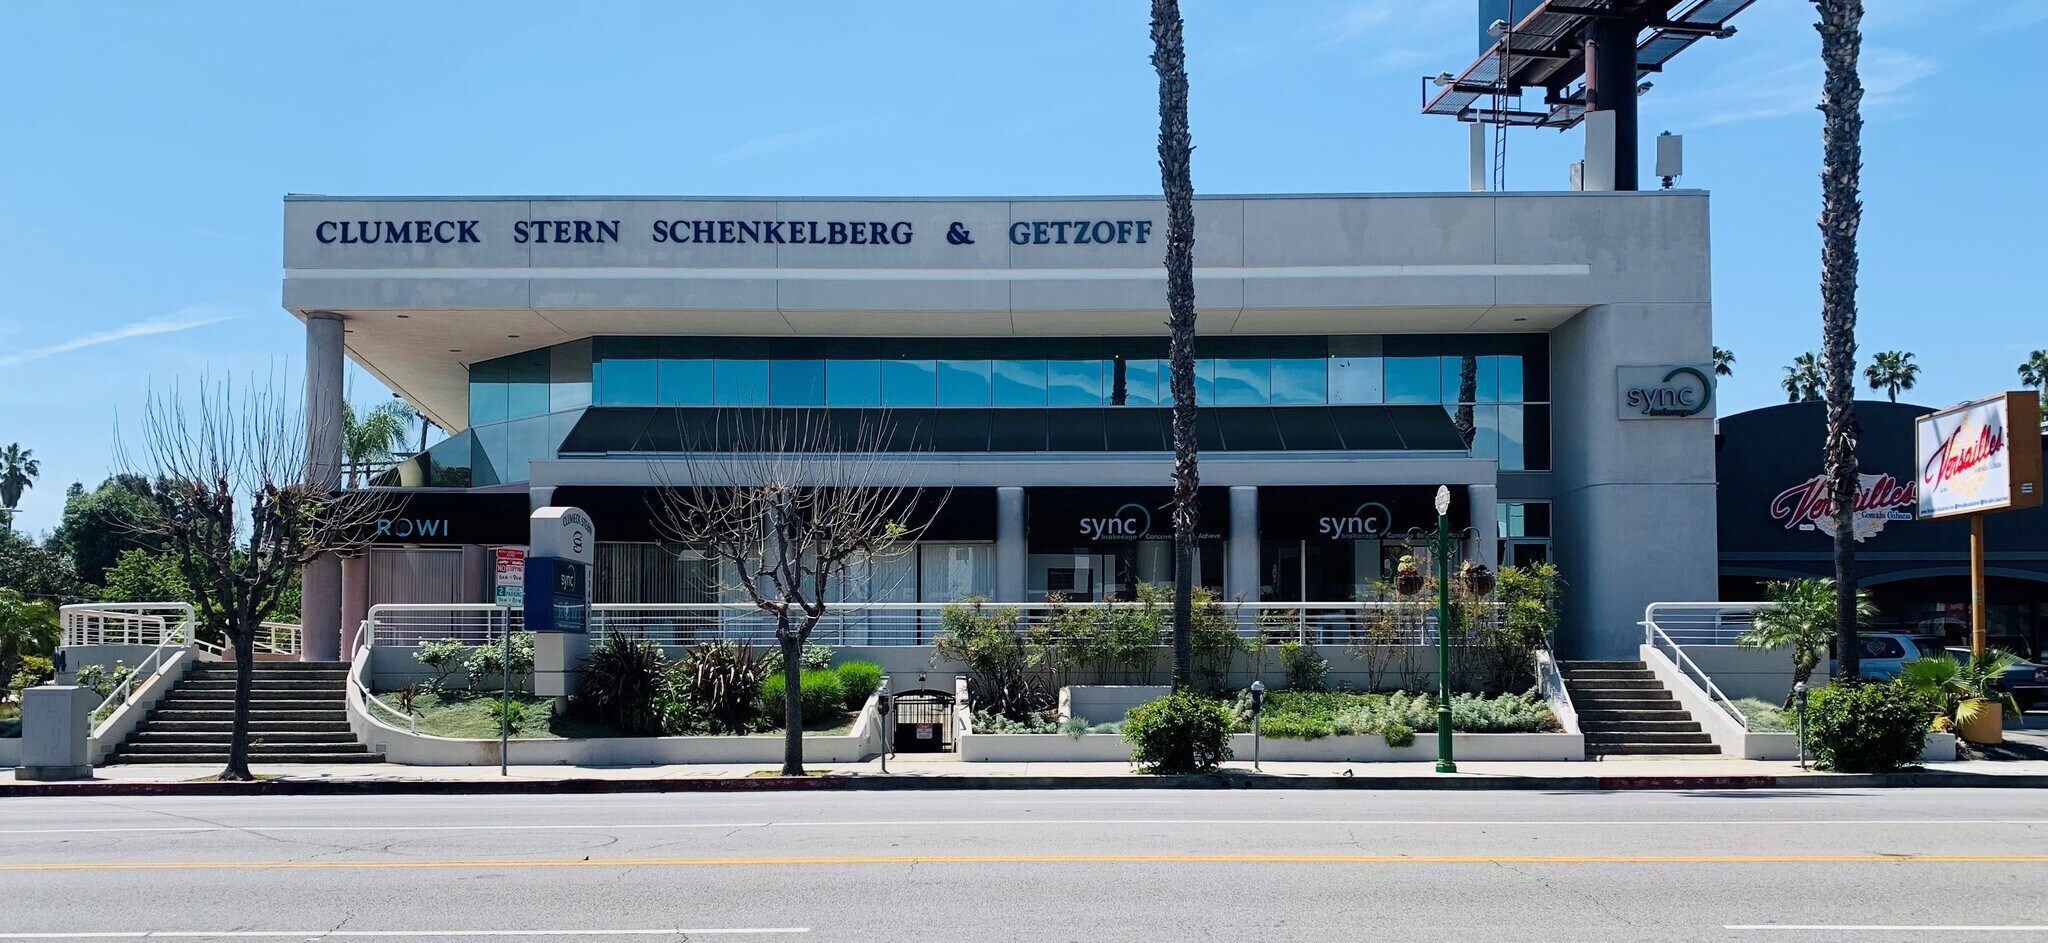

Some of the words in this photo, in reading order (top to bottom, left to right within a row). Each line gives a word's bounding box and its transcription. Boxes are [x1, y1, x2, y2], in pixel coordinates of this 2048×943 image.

[316, 220, 480, 244] CLUMECK
[513, 220, 620, 244] STERN
[652, 220, 913, 245] SCHENKELBERG
[946, 221, 975, 245] &
[1008, 220, 1153, 245] GETZOFF
[1627, 387, 1695, 414] sync
[1924, 424, 2004, 493] Versailles
[376, 518, 448, 537] ROWI
[1080, 517, 1137, 541] sync
[1319, 516, 1377, 540] sync
[499, 587, 504, 596] 2
[560, 574, 574, 590] sync
